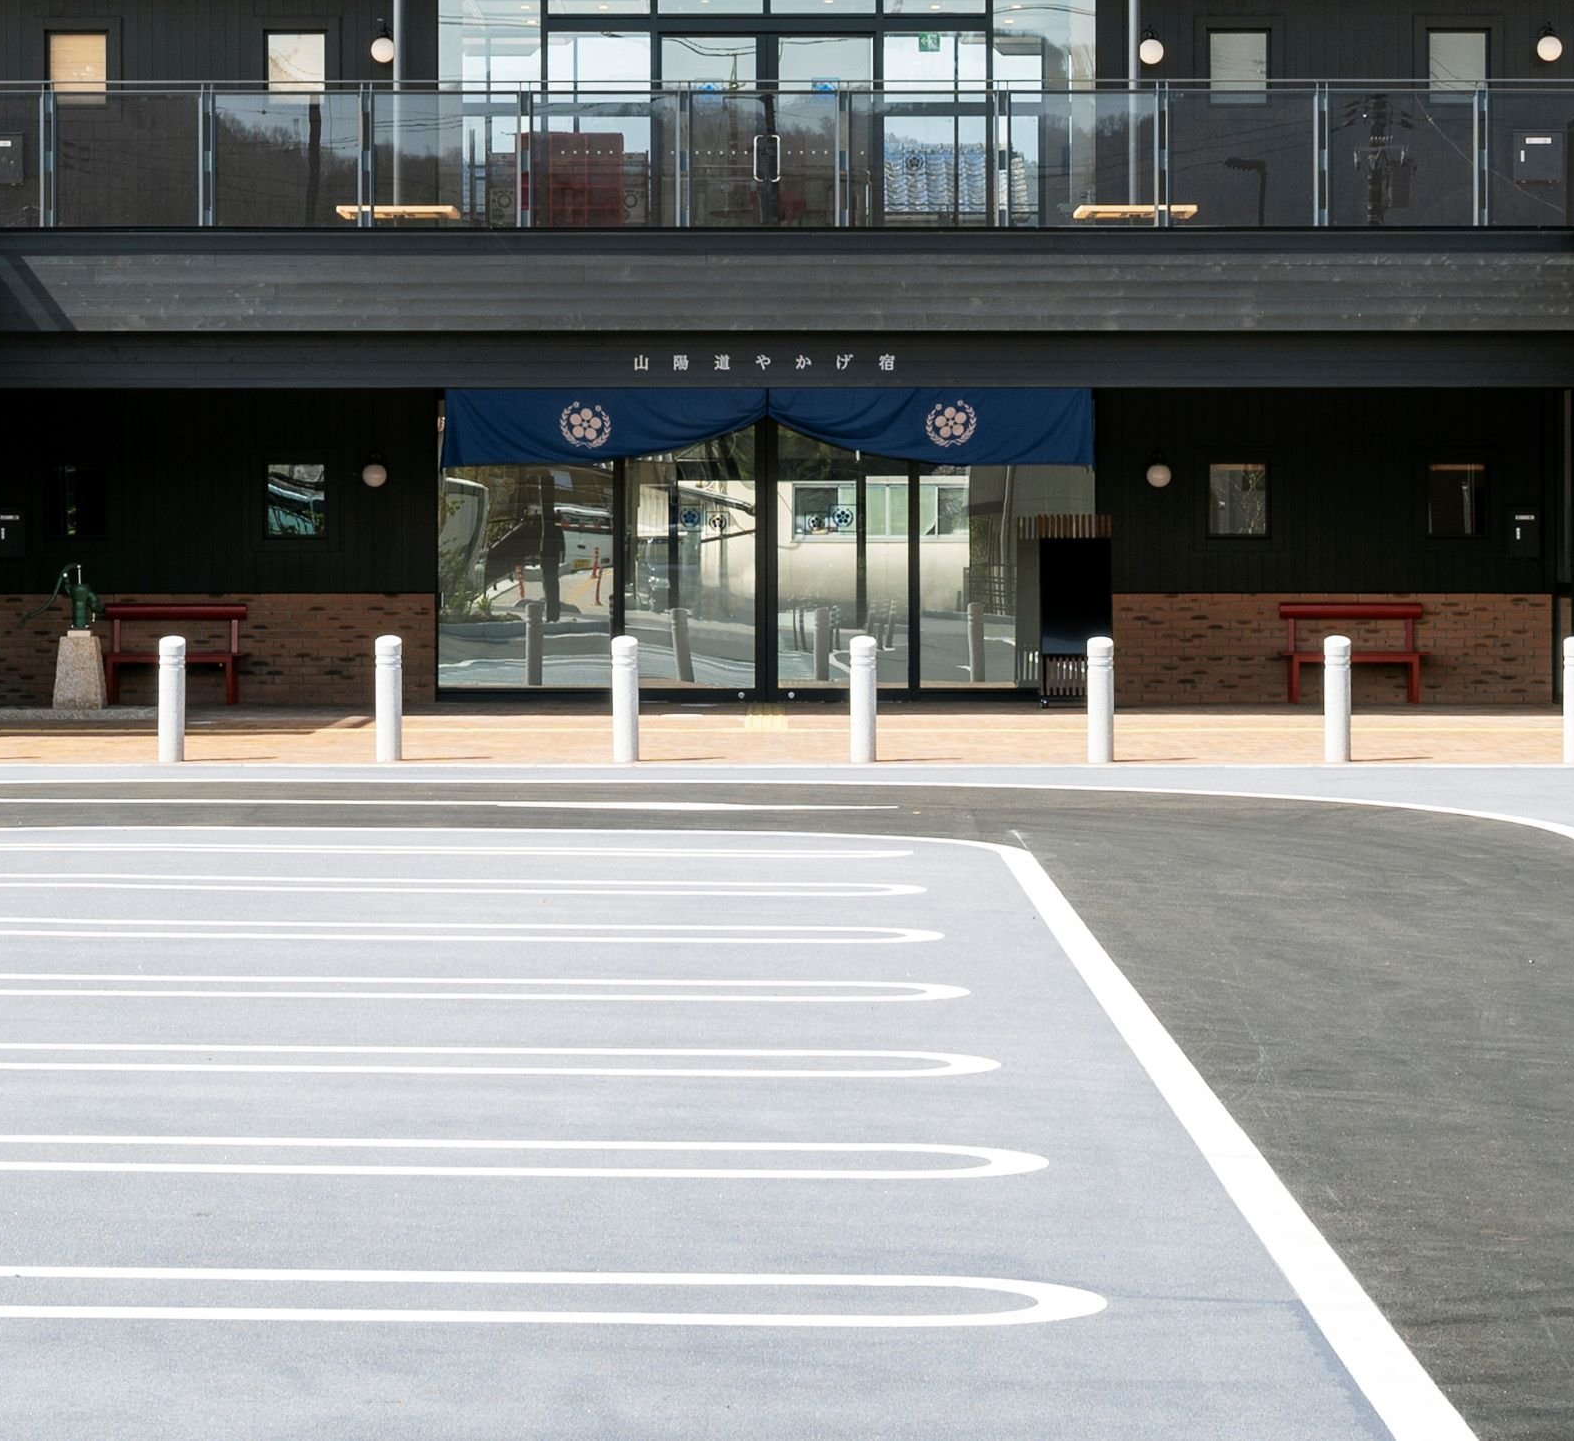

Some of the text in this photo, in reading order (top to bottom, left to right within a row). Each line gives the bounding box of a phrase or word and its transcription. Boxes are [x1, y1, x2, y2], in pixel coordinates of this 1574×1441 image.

[633, 355, 896, 371] 山陽道やかげ宿
